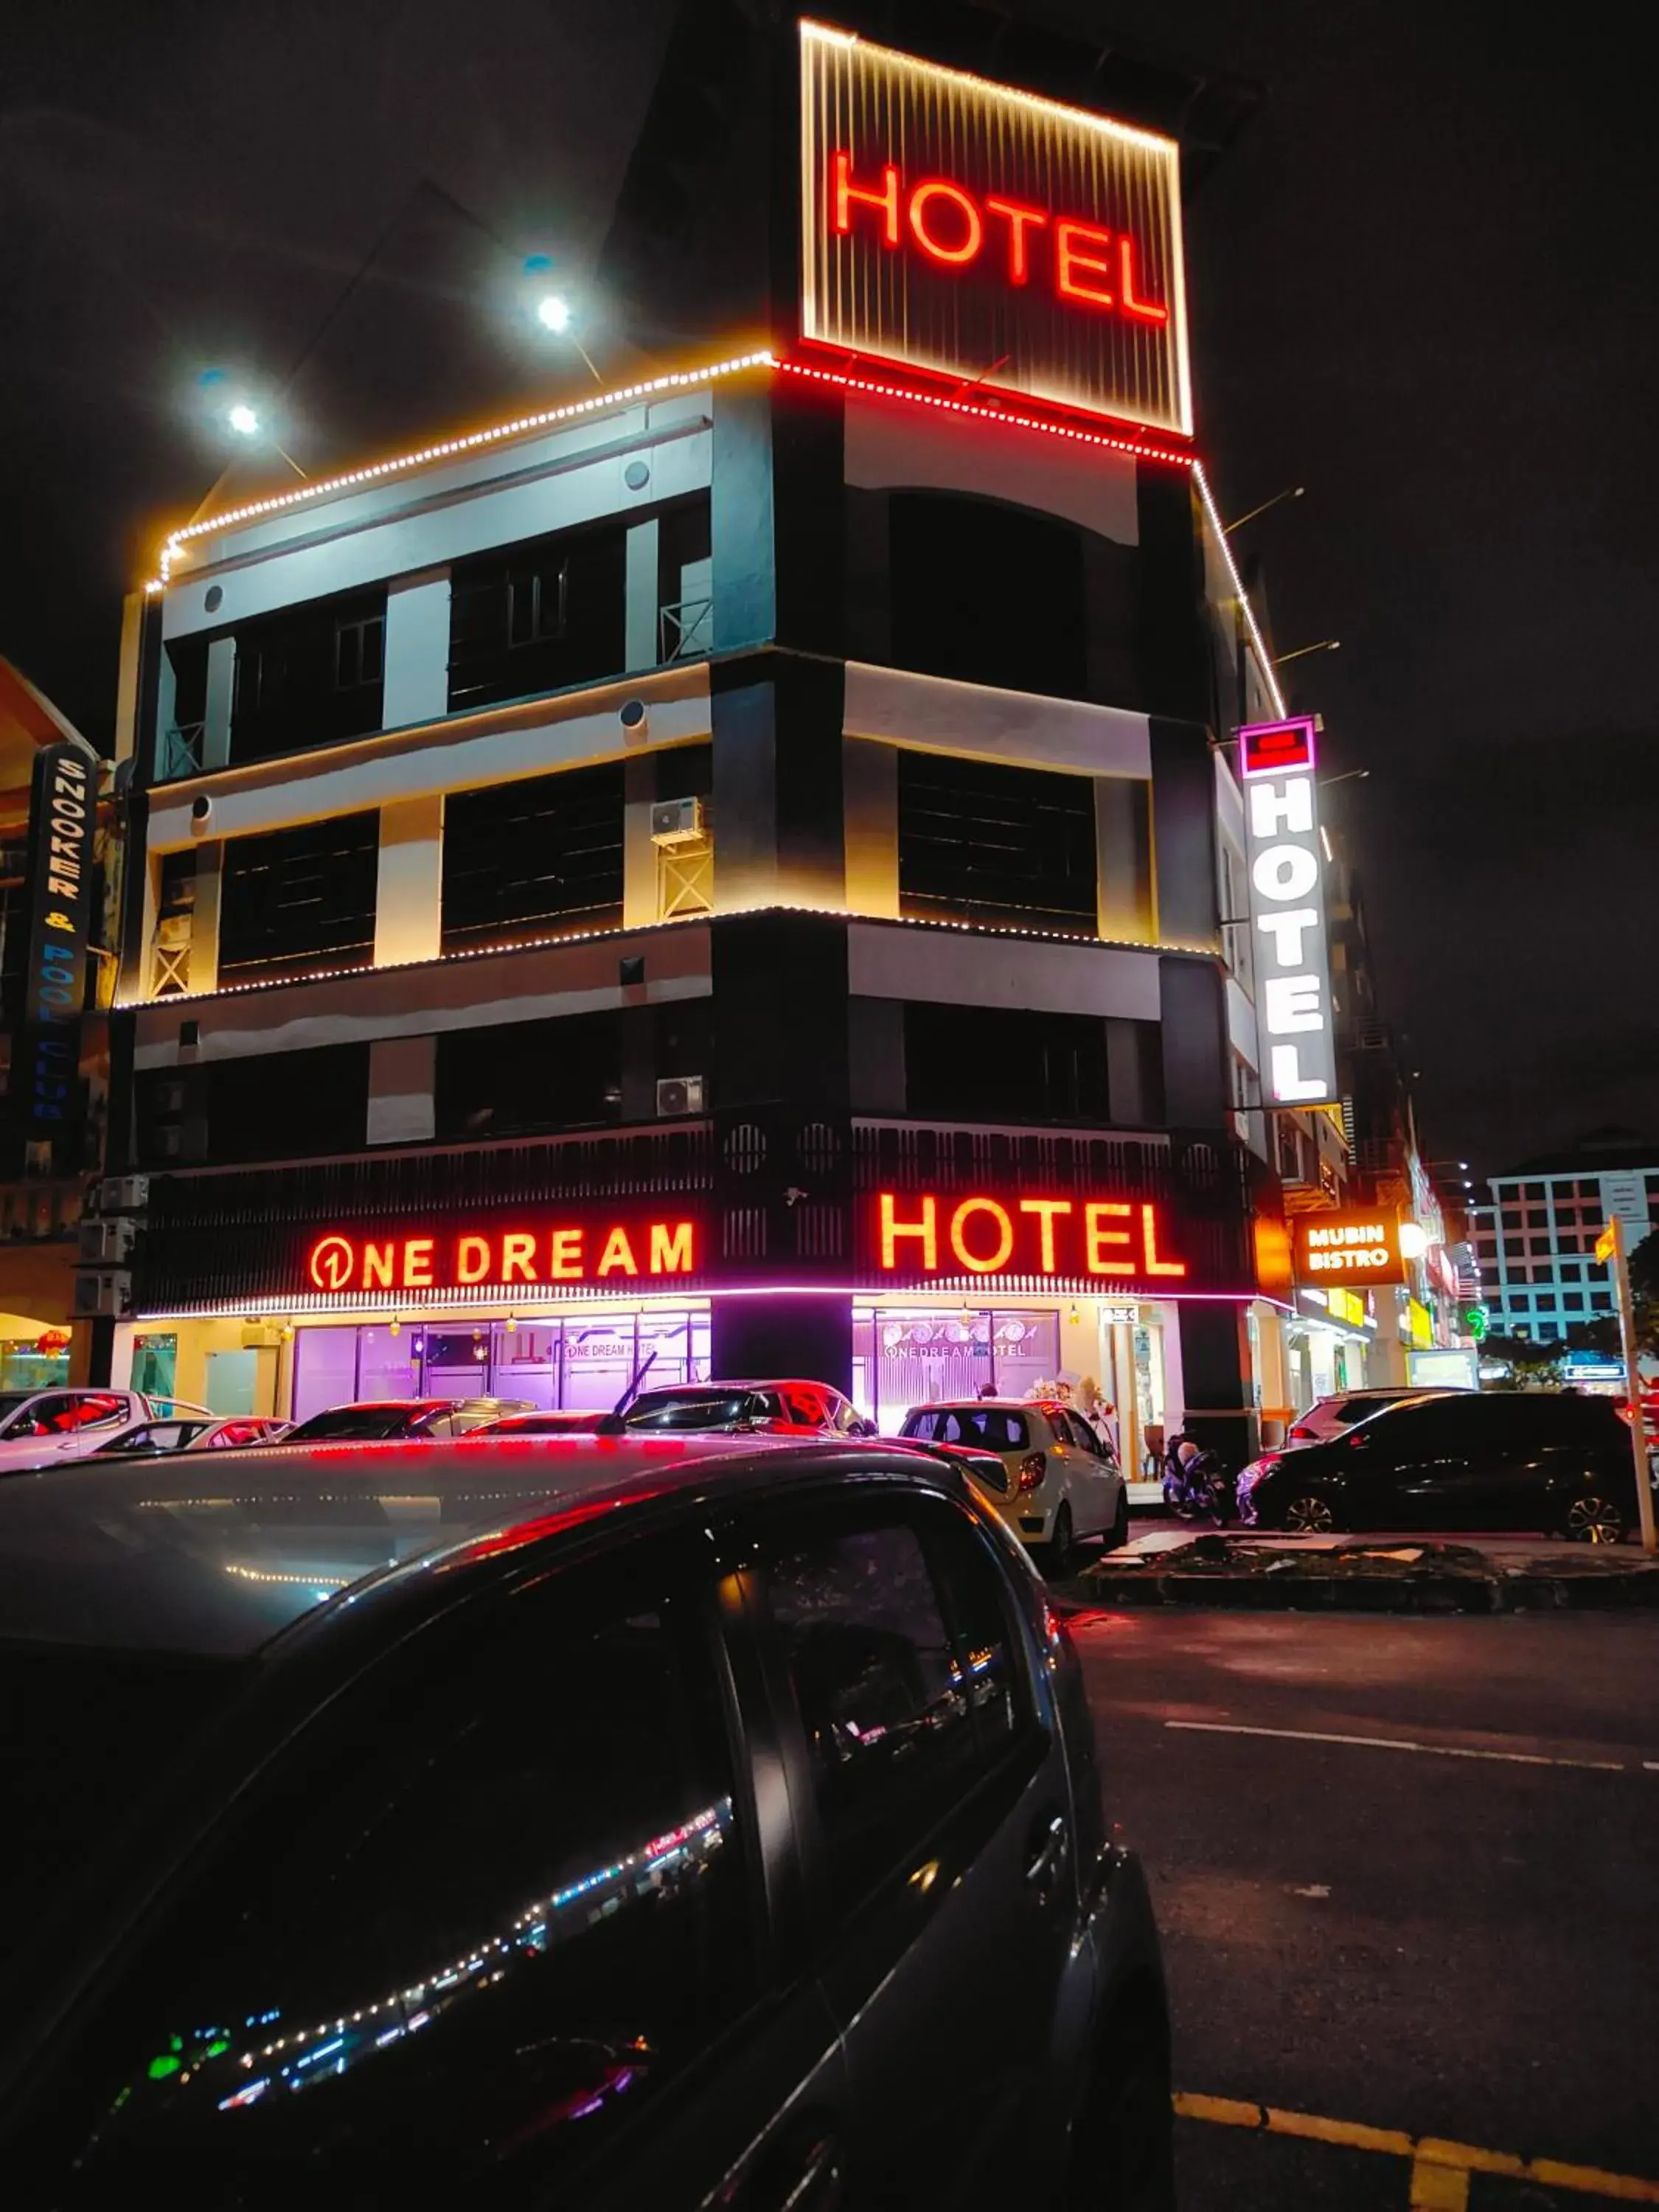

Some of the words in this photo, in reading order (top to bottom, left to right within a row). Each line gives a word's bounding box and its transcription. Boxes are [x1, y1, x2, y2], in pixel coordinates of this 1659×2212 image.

[830, 150, 1169, 326] HOTEL
[47, 757, 87, 900] SNOOKER
[44, 910, 77, 933] &
[1250, 777, 1327, 1101] HOTEL
[40, 943, 74, 1026] POOL
[456, 1222, 693, 1284] DREAM
[880, 1193, 1185, 1276] HOTEL
[1309, 1225, 1385, 1247] MUBIN
[1309, 1248, 1388, 1270] BISTRO
